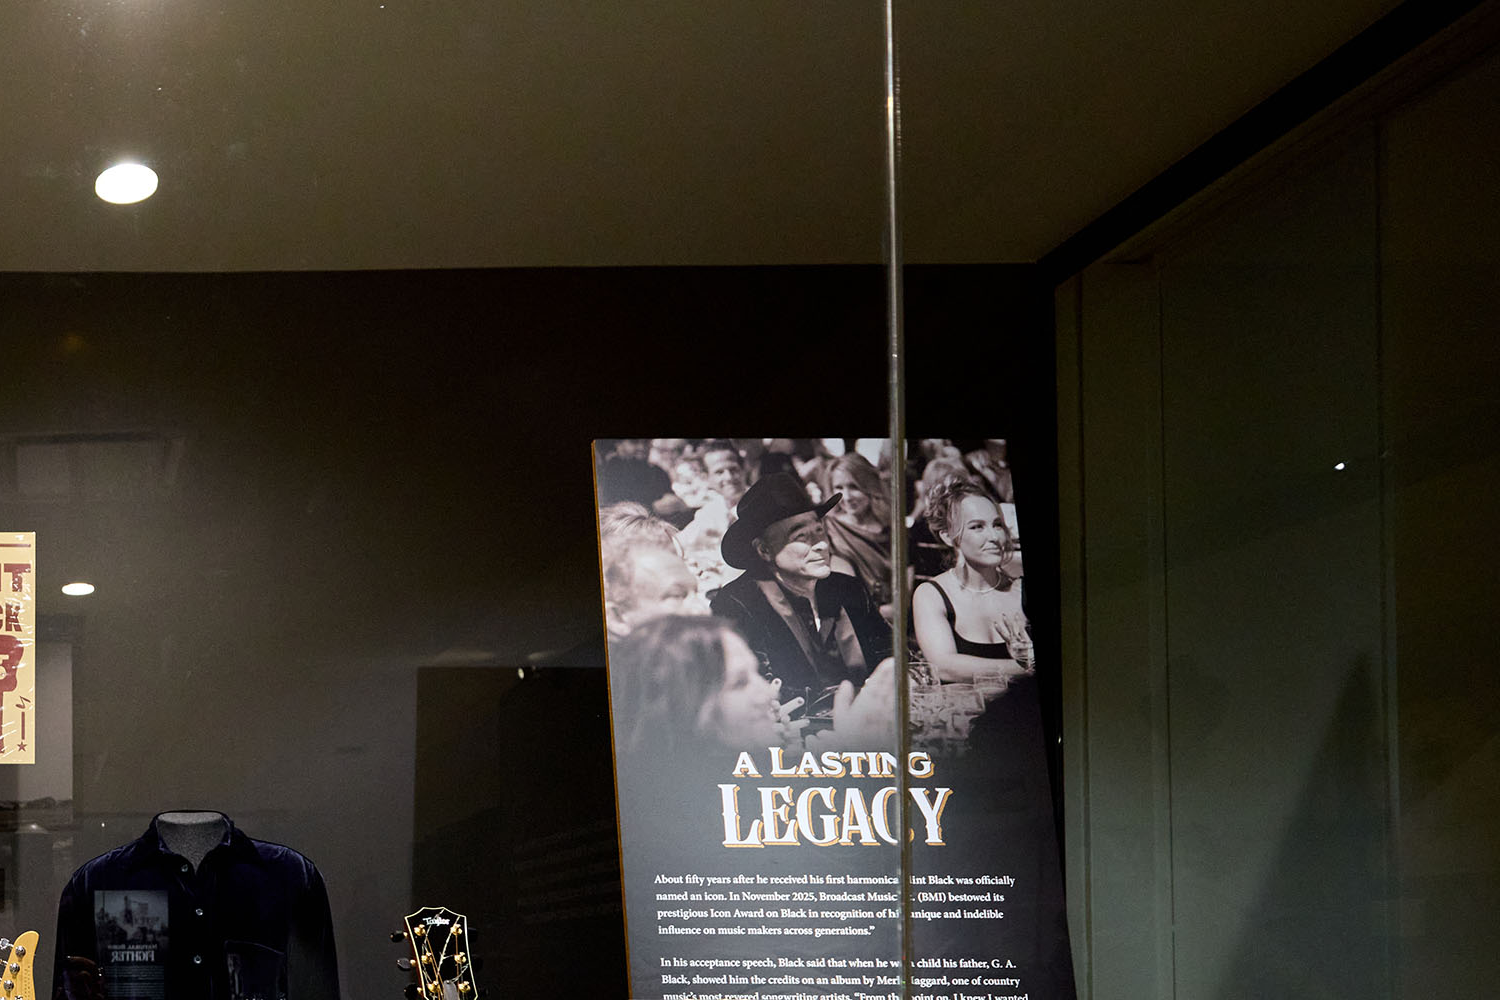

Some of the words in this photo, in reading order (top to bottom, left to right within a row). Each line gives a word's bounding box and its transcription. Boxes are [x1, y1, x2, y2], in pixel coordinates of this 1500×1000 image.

[731, 751, 760, 778] A
[768, 746, 934, 780] LASTING
[716, 782, 953, 848] LEGACY
[654, 874, 683, 883] About
[685, 874, 704, 886] fifty
[706, 877, 731, 886] years
[732, 874, 754, 883] after
[756, 874, 768, 883] he
[770, 874, 807, 883] received
[809, 874, 824, 883] his
[825, 874, 845, 884] first
[846, 874, 899, 884] harmonica
[928, 875, 954, 884] Black
[975, 875, 1015, 887] officially
[658, 924, 701, 934] influence
[717, 925, 745, 934] music
[747, 925, 782, 934] makers
